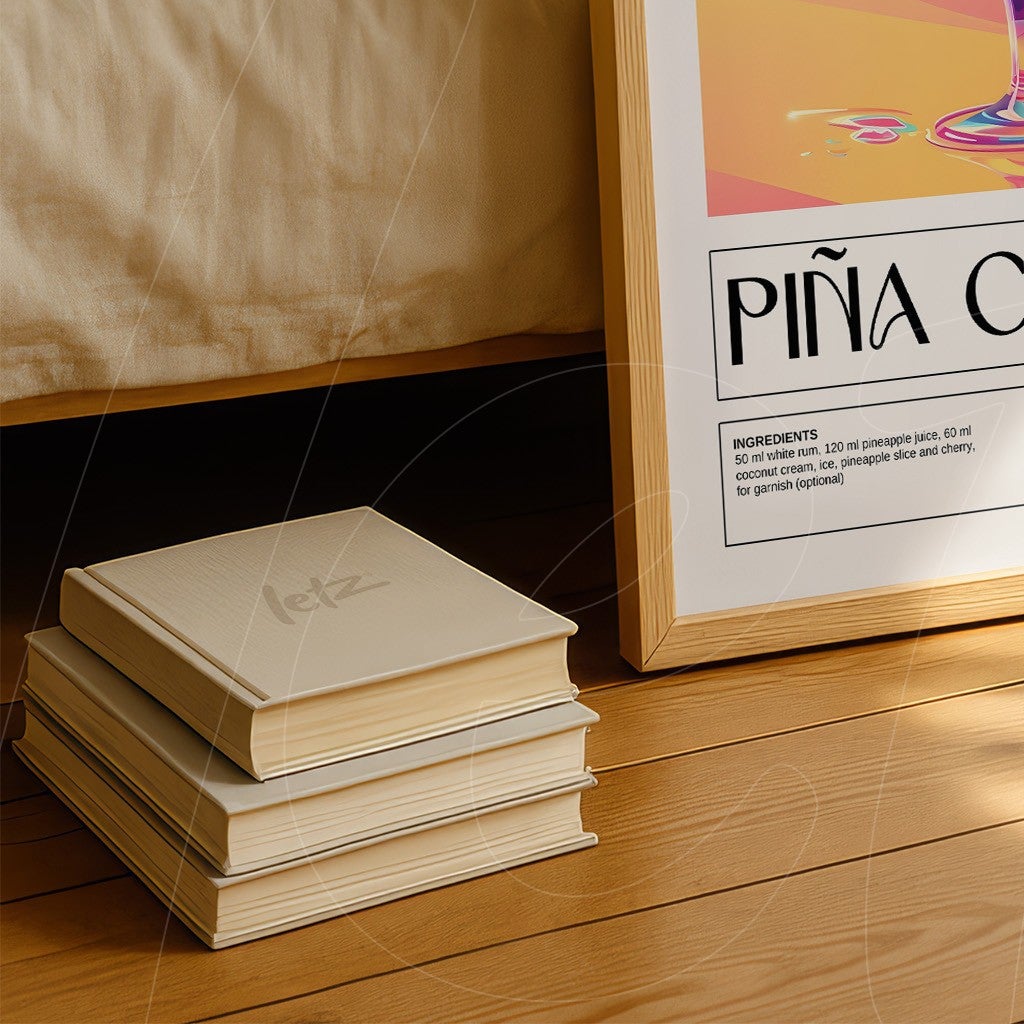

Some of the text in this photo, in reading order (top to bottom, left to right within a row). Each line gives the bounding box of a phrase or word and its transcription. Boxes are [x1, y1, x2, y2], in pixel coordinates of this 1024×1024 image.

[727, 247, 931, 365] PIÑA
[733, 428, 818, 450] INGREDIENTS
[735, 453, 749, 466] 50
[751, 450, 764, 463] ml
[766, 447, 795, 461] white
[824, 441, 844, 454] 120
[846, 438, 860, 451] ml
[861, 433, 912, 452] pineapple
[914, 430, 941, 445] juice,
[943, 427, 957, 439] 60
[959, 424, 972, 437] ml
[735, 442, 976, 481] coconut cream, ice, pineapple slice and cherry,
[736, 472, 844, 497] for garnish (optional)
[262, 573, 391, 625] letz
